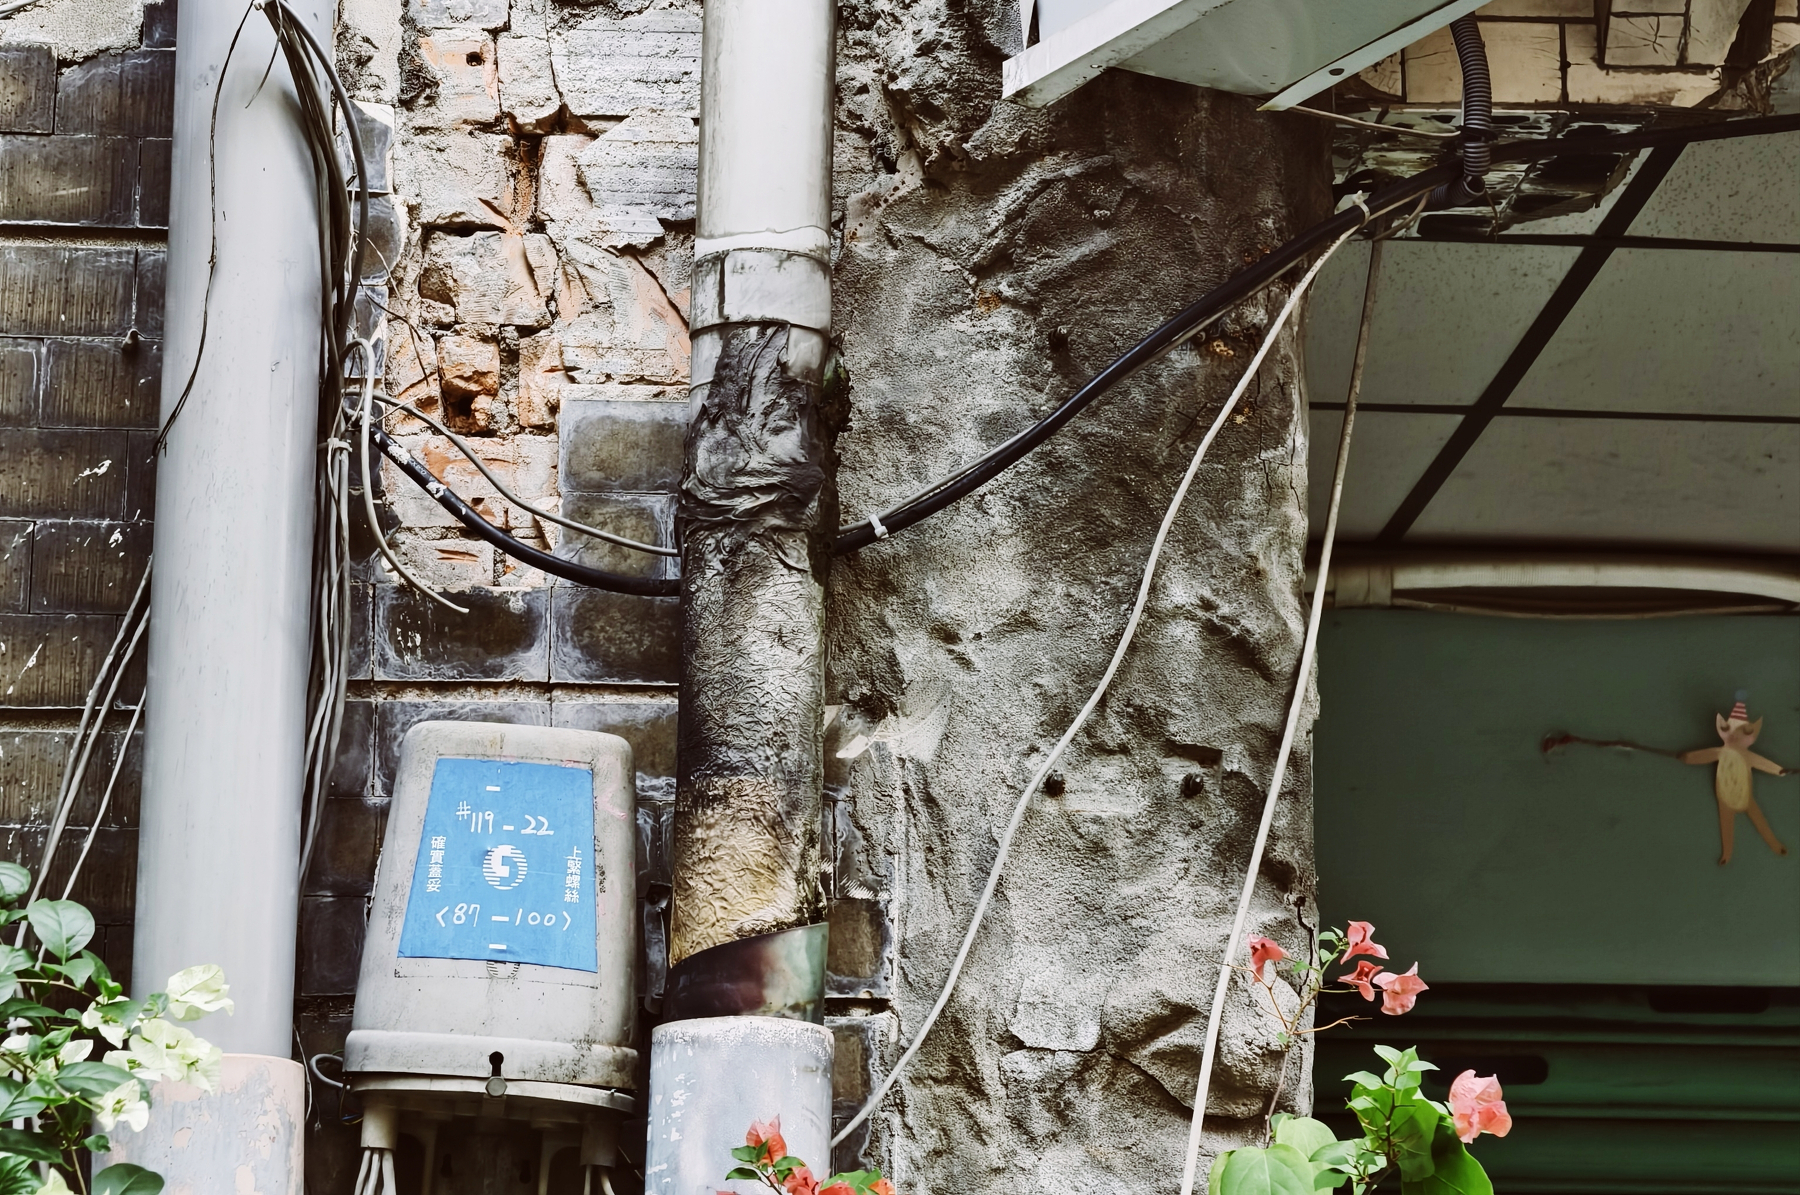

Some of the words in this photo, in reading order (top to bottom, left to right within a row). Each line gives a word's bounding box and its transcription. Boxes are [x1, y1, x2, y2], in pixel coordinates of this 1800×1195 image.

[426, 835, 447, 893] 確實蓋妥
[564, 845, 583, 904] 上緊螺絲
